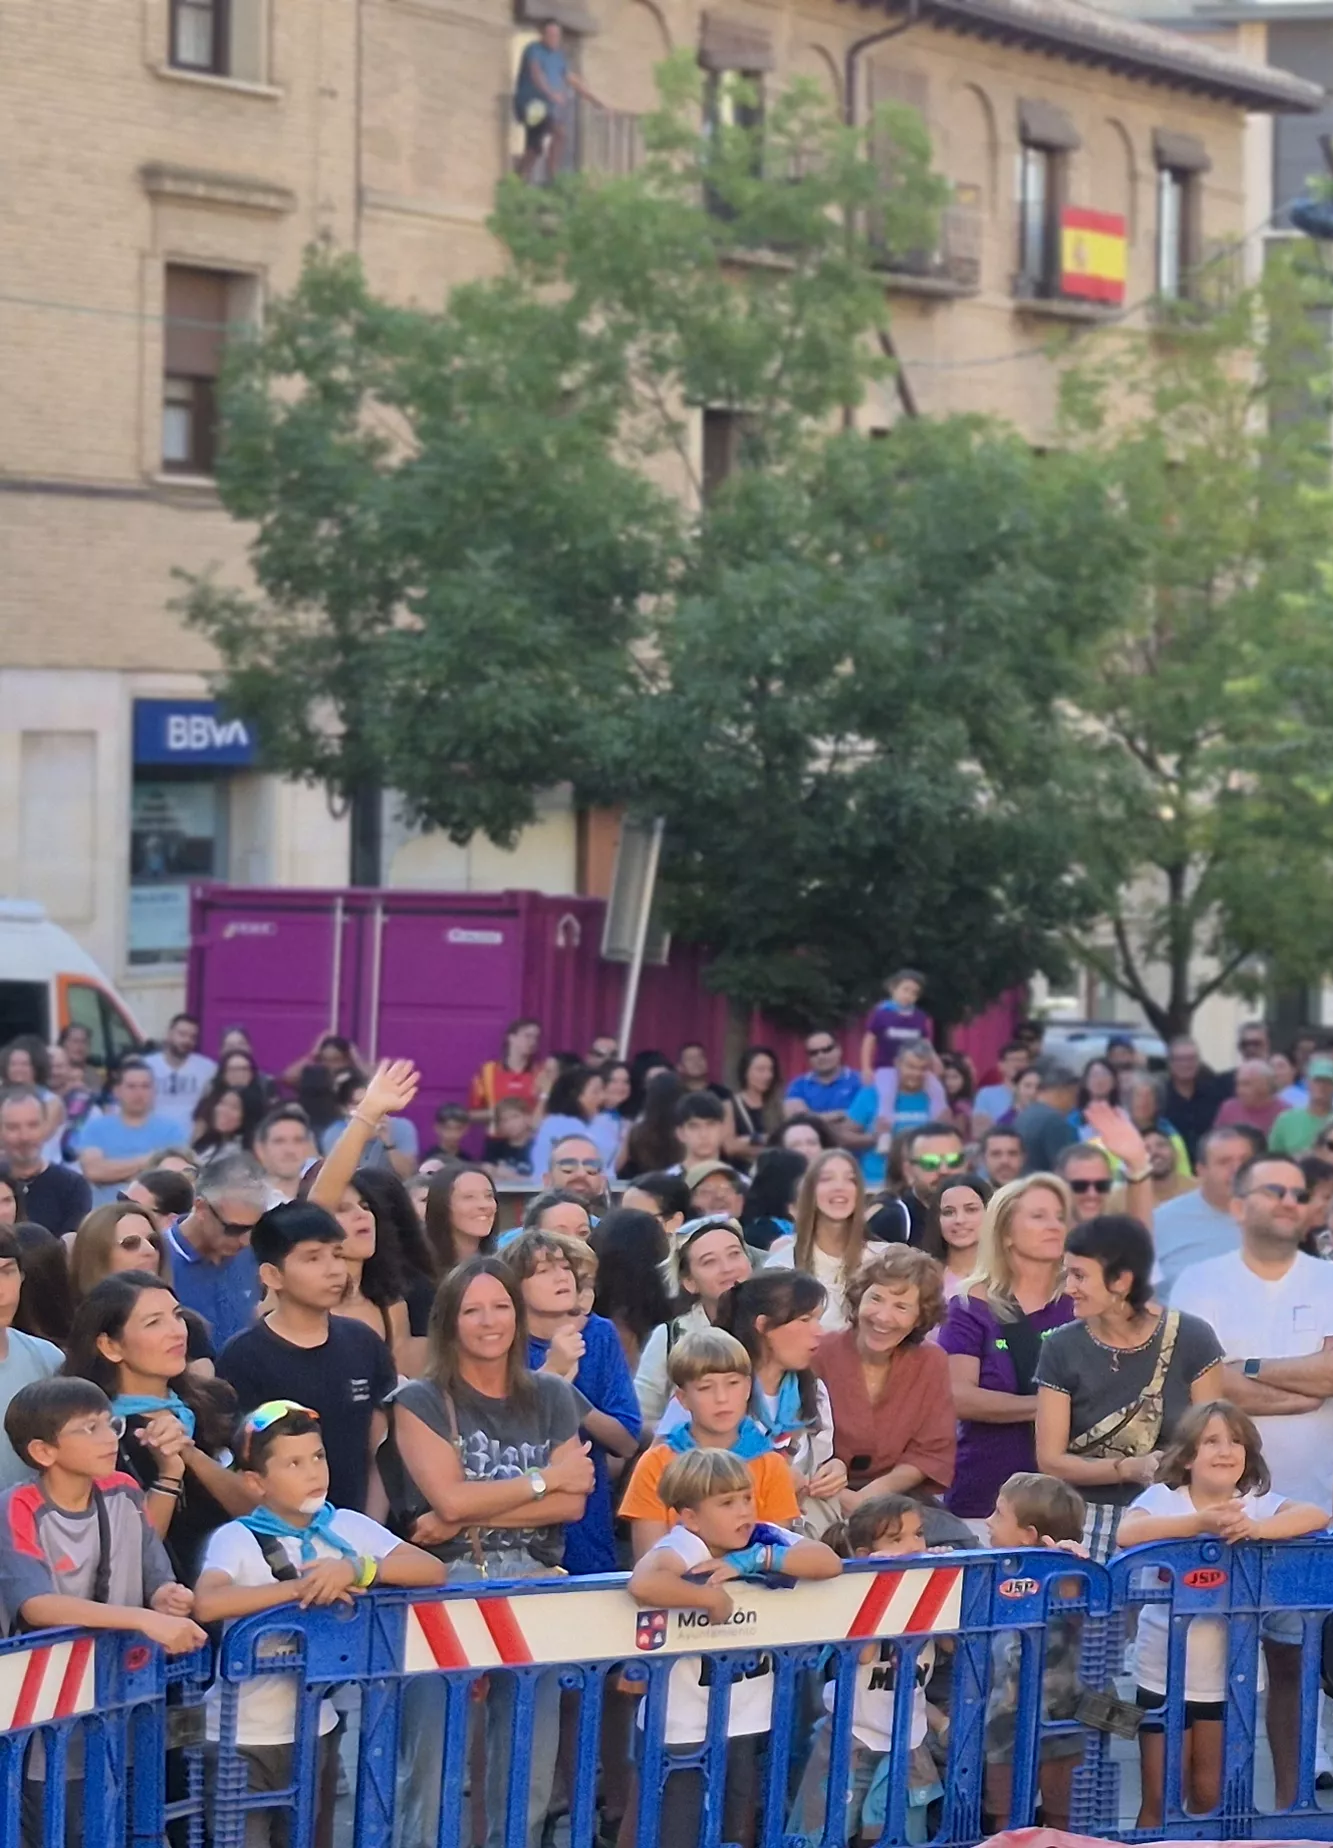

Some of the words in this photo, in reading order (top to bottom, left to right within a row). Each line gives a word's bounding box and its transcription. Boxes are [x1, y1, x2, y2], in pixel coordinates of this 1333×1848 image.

[167, 714, 249, 750] BBVA
[1005, 1580, 1035, 1593] JSP
[1189, 1571, 1221, 1584] JSP
[677, 1606, 757, 1629] Mozón
